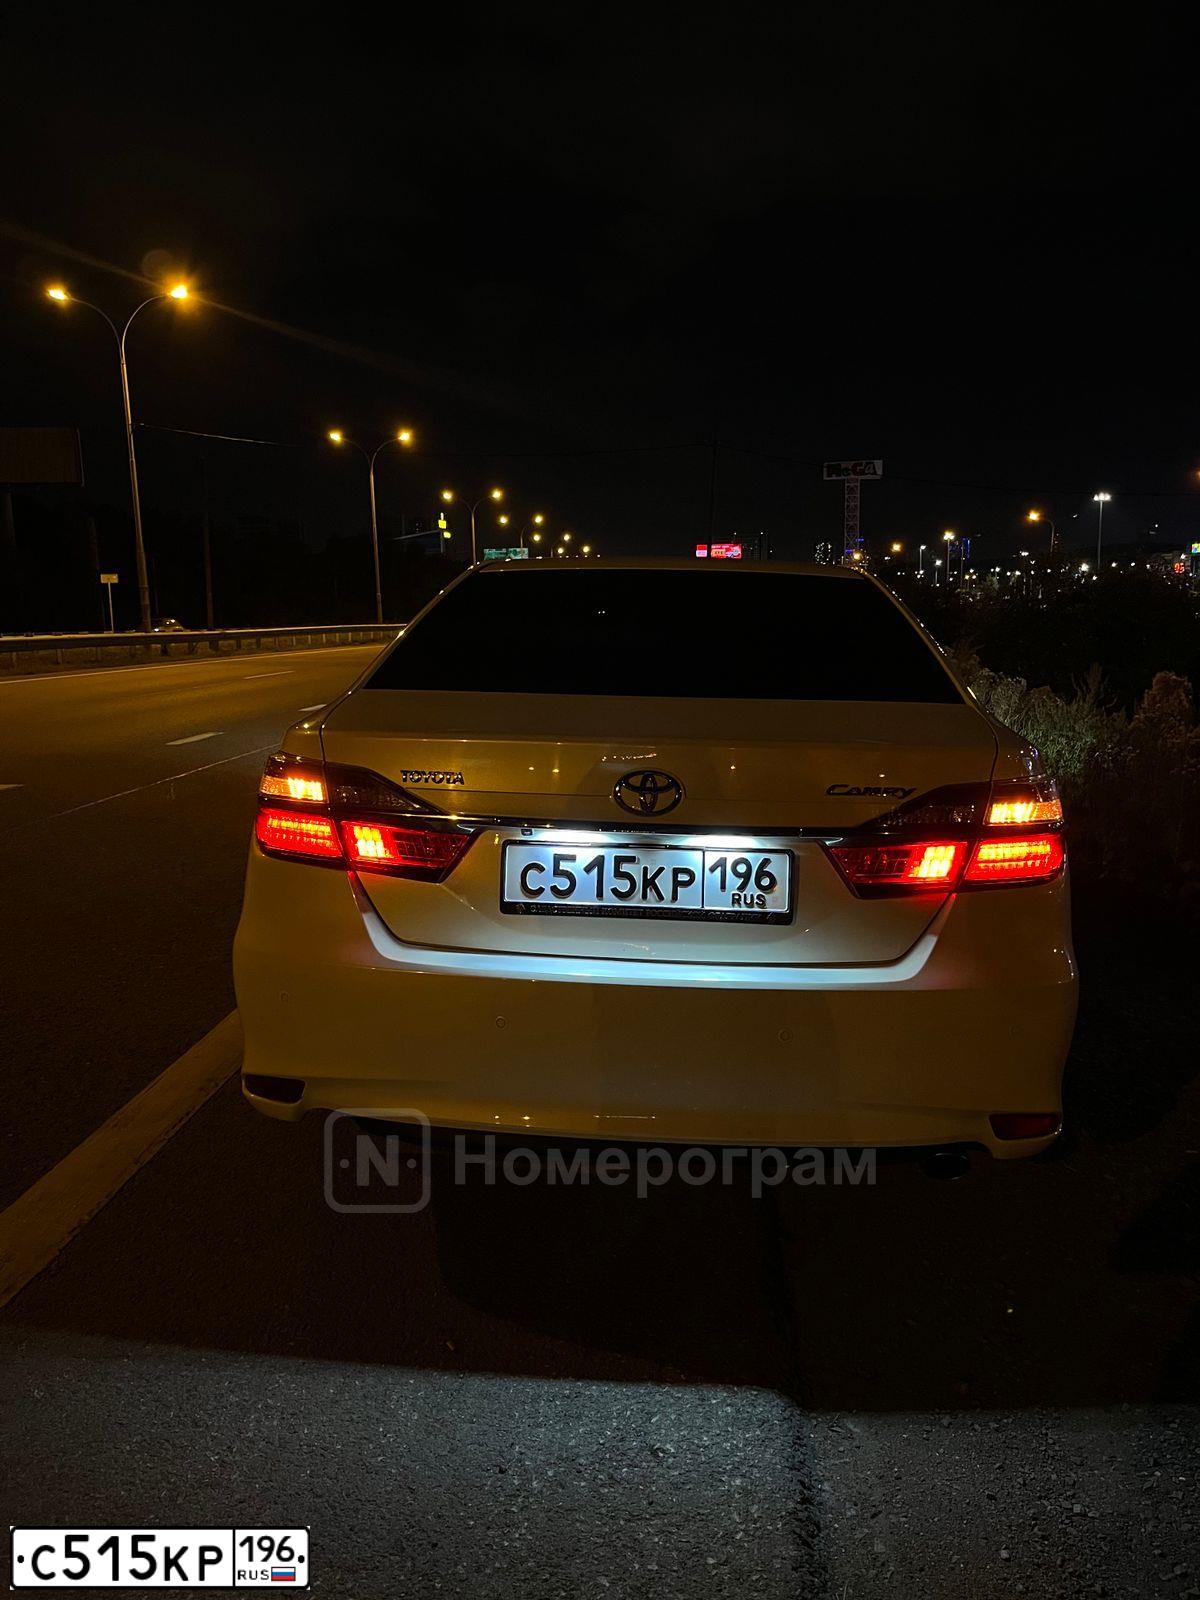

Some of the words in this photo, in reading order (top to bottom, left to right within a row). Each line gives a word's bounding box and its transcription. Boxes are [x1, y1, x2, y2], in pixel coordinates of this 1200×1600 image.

[400, 770, 465, 785] TOYOTA
[708, 857, 777, 893] 196
[731, 893, 767, 909] RUS
